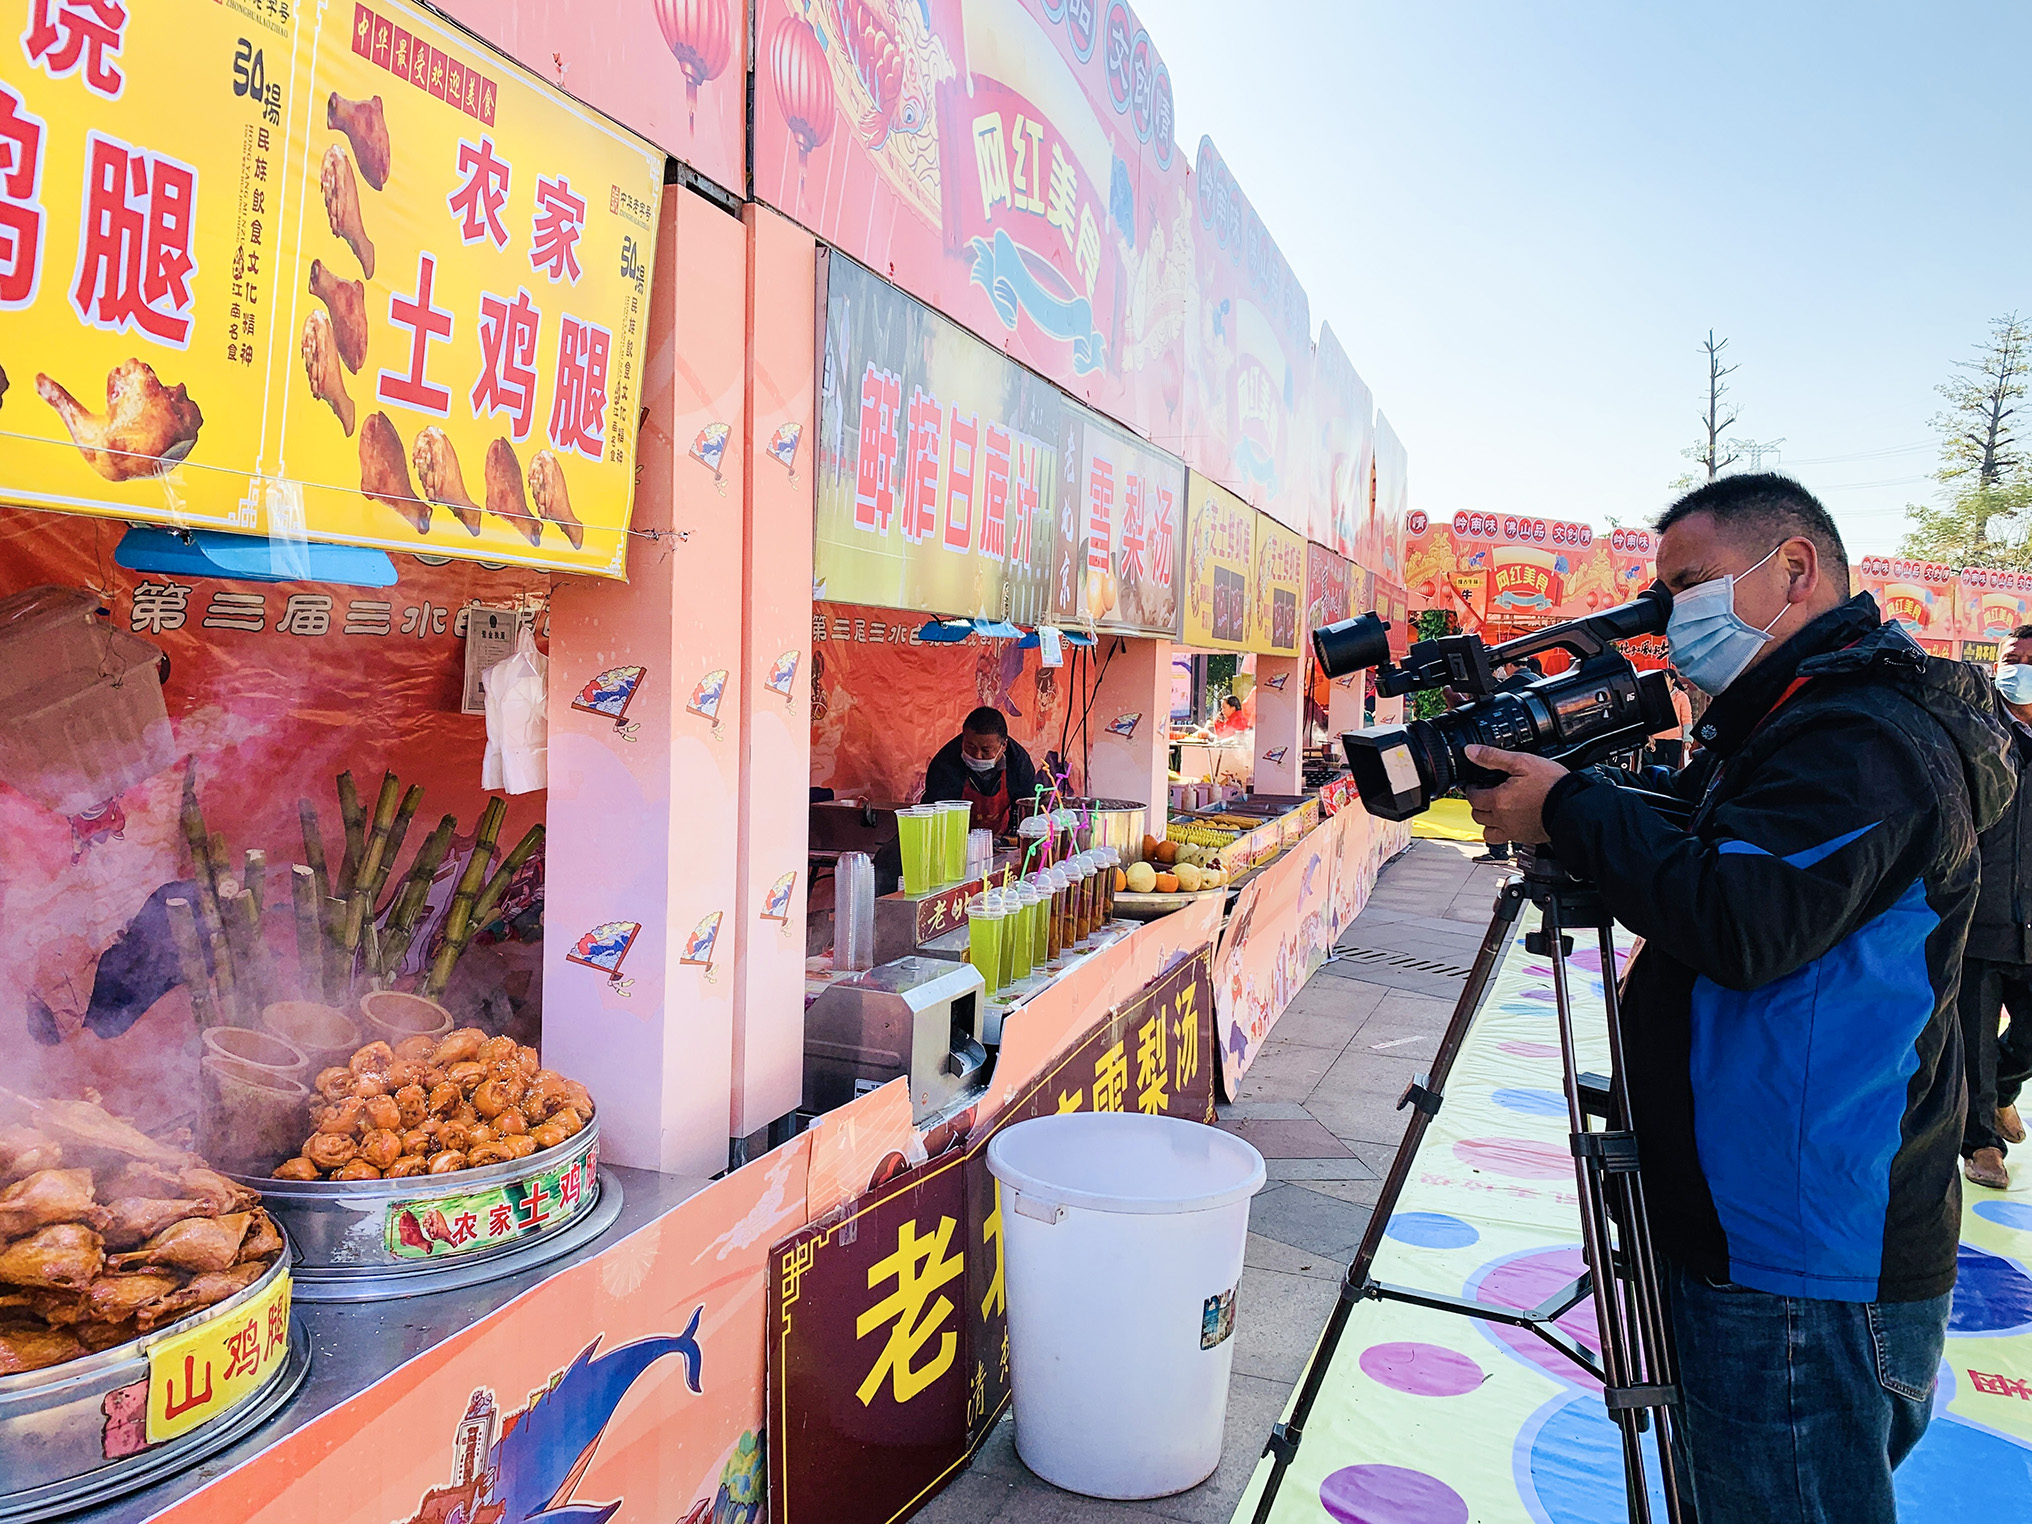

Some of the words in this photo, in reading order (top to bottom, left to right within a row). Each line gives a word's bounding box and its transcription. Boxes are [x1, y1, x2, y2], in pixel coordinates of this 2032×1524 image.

[357, 11, 495, 118] 中华最受欢迎美食
[448, 135, 588, 285] 农家
[971, 111, 1101, 294] 网红美食
[378, 252, 611, 461] 土鸡腿
[855, 361, 1039, 569] 鲜榨甘蔗汁
[1087, 454, 1176, 590] 雪梨汤
[1455, 514, 1498, 535] 岭南味
[1506, 519, 1546, 539] 佛山品
[1496, 565, 1549, 594] 网红美食
[1613, 532, 1650, 551] 岭南味
[165, 1293, 285, 1420] 山鸡腿
